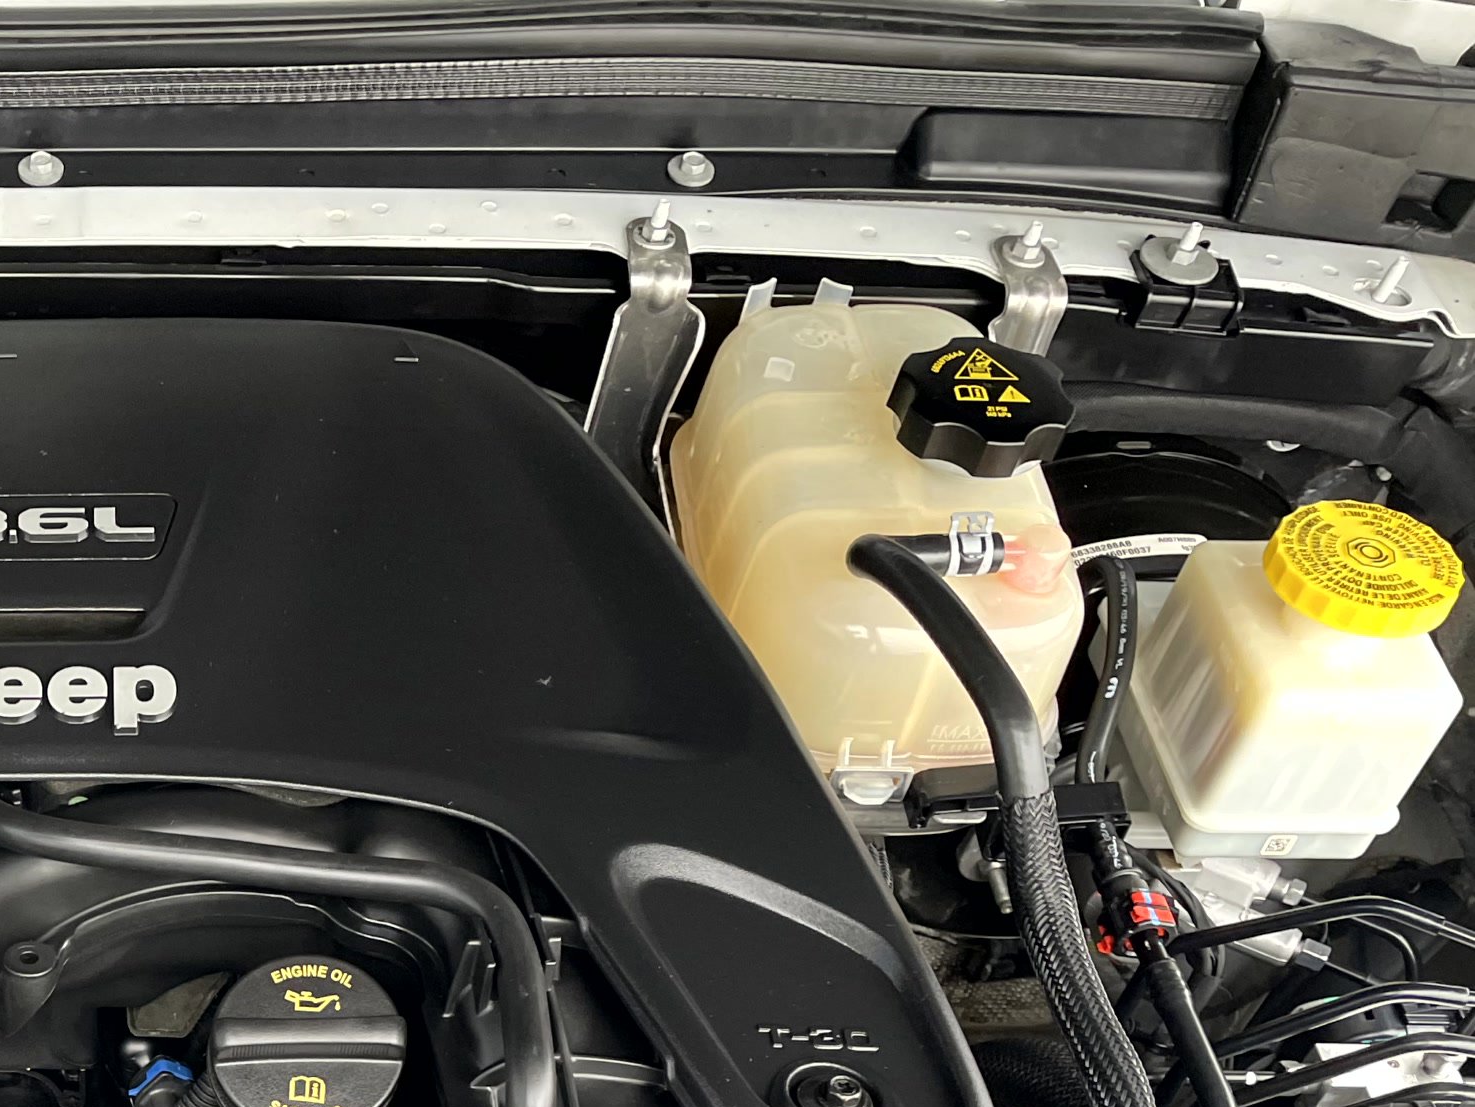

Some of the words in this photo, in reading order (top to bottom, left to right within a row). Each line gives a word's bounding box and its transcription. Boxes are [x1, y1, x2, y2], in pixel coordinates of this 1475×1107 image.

[1372, 513, 1392, 523] USE
[1324, 576, 1368, 596] RETIRER
[1339, 574, 1362, 587] DOT
[1444, 575, 1459, 588] DOT
[270, 964, 329, 984] ENGINE
[330, 968, 354, 989] OIL
[755, 1024, 880, 1051] T-30
